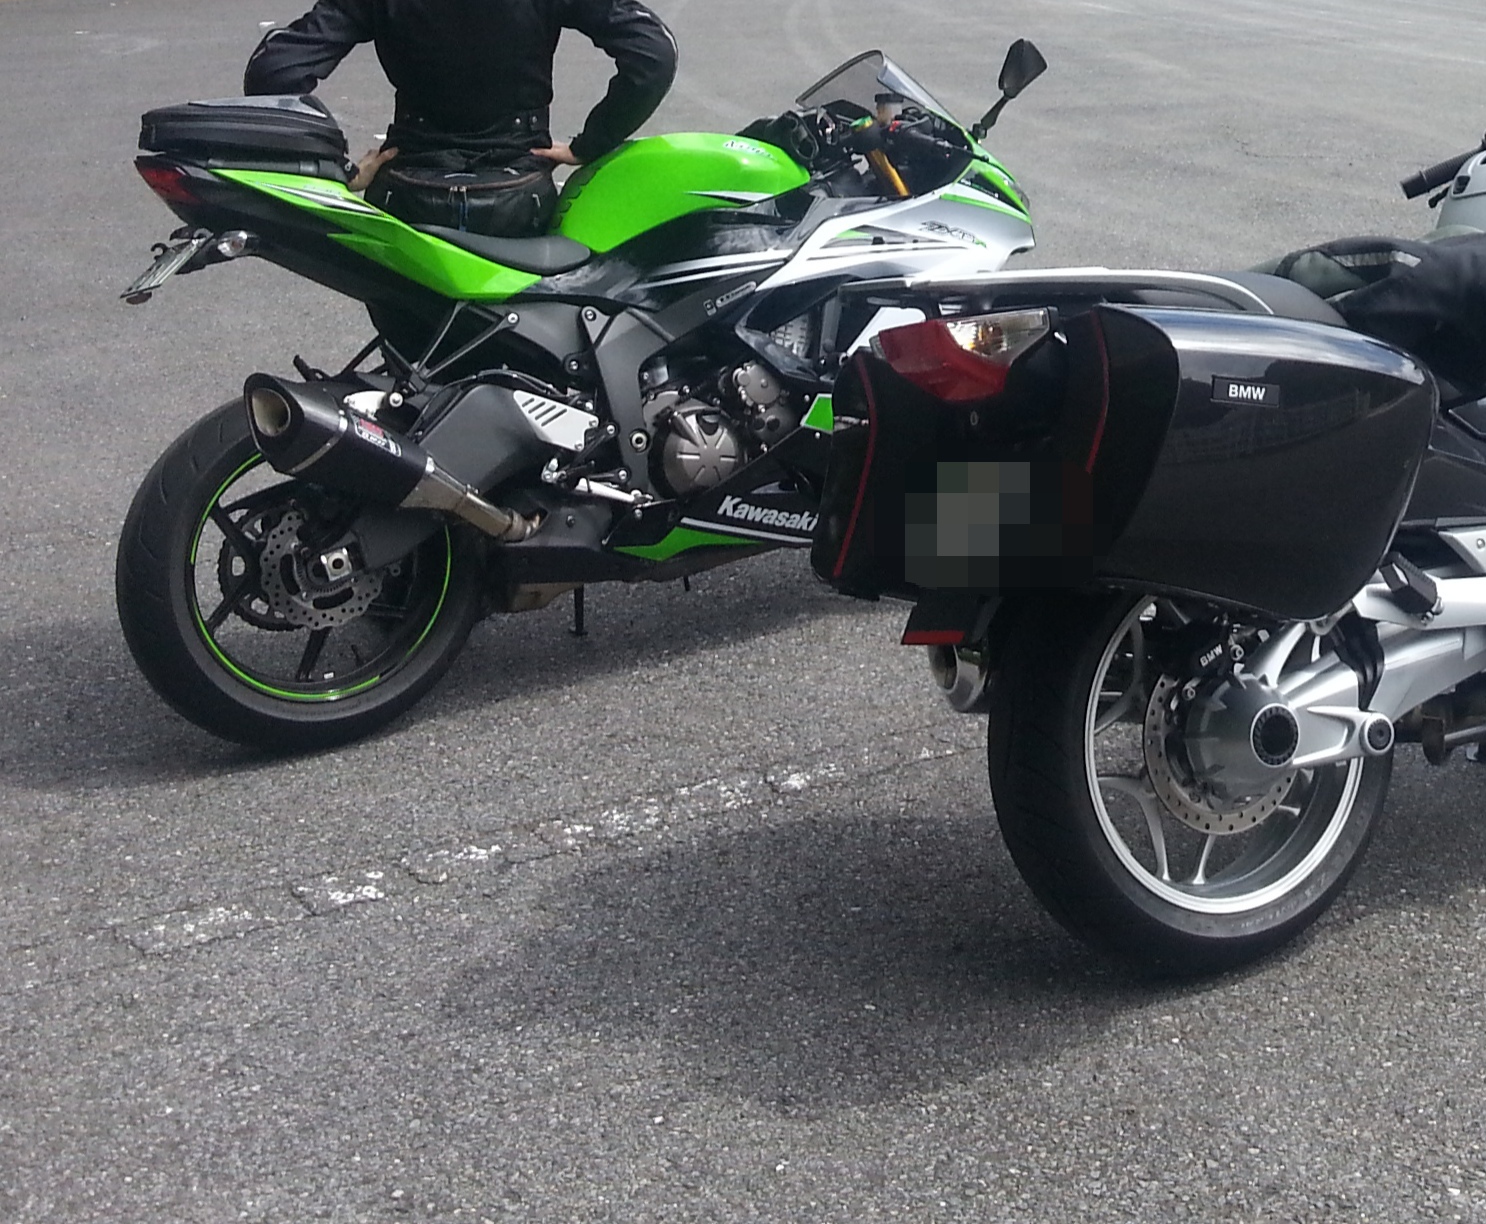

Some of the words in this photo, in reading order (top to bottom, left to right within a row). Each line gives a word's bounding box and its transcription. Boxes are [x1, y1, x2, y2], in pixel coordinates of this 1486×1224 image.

[1228, 383, 1266, 401] BMW
[717, 495, 819, 532] Kawasaki
[1200, 643, 1223, 667] BMW
